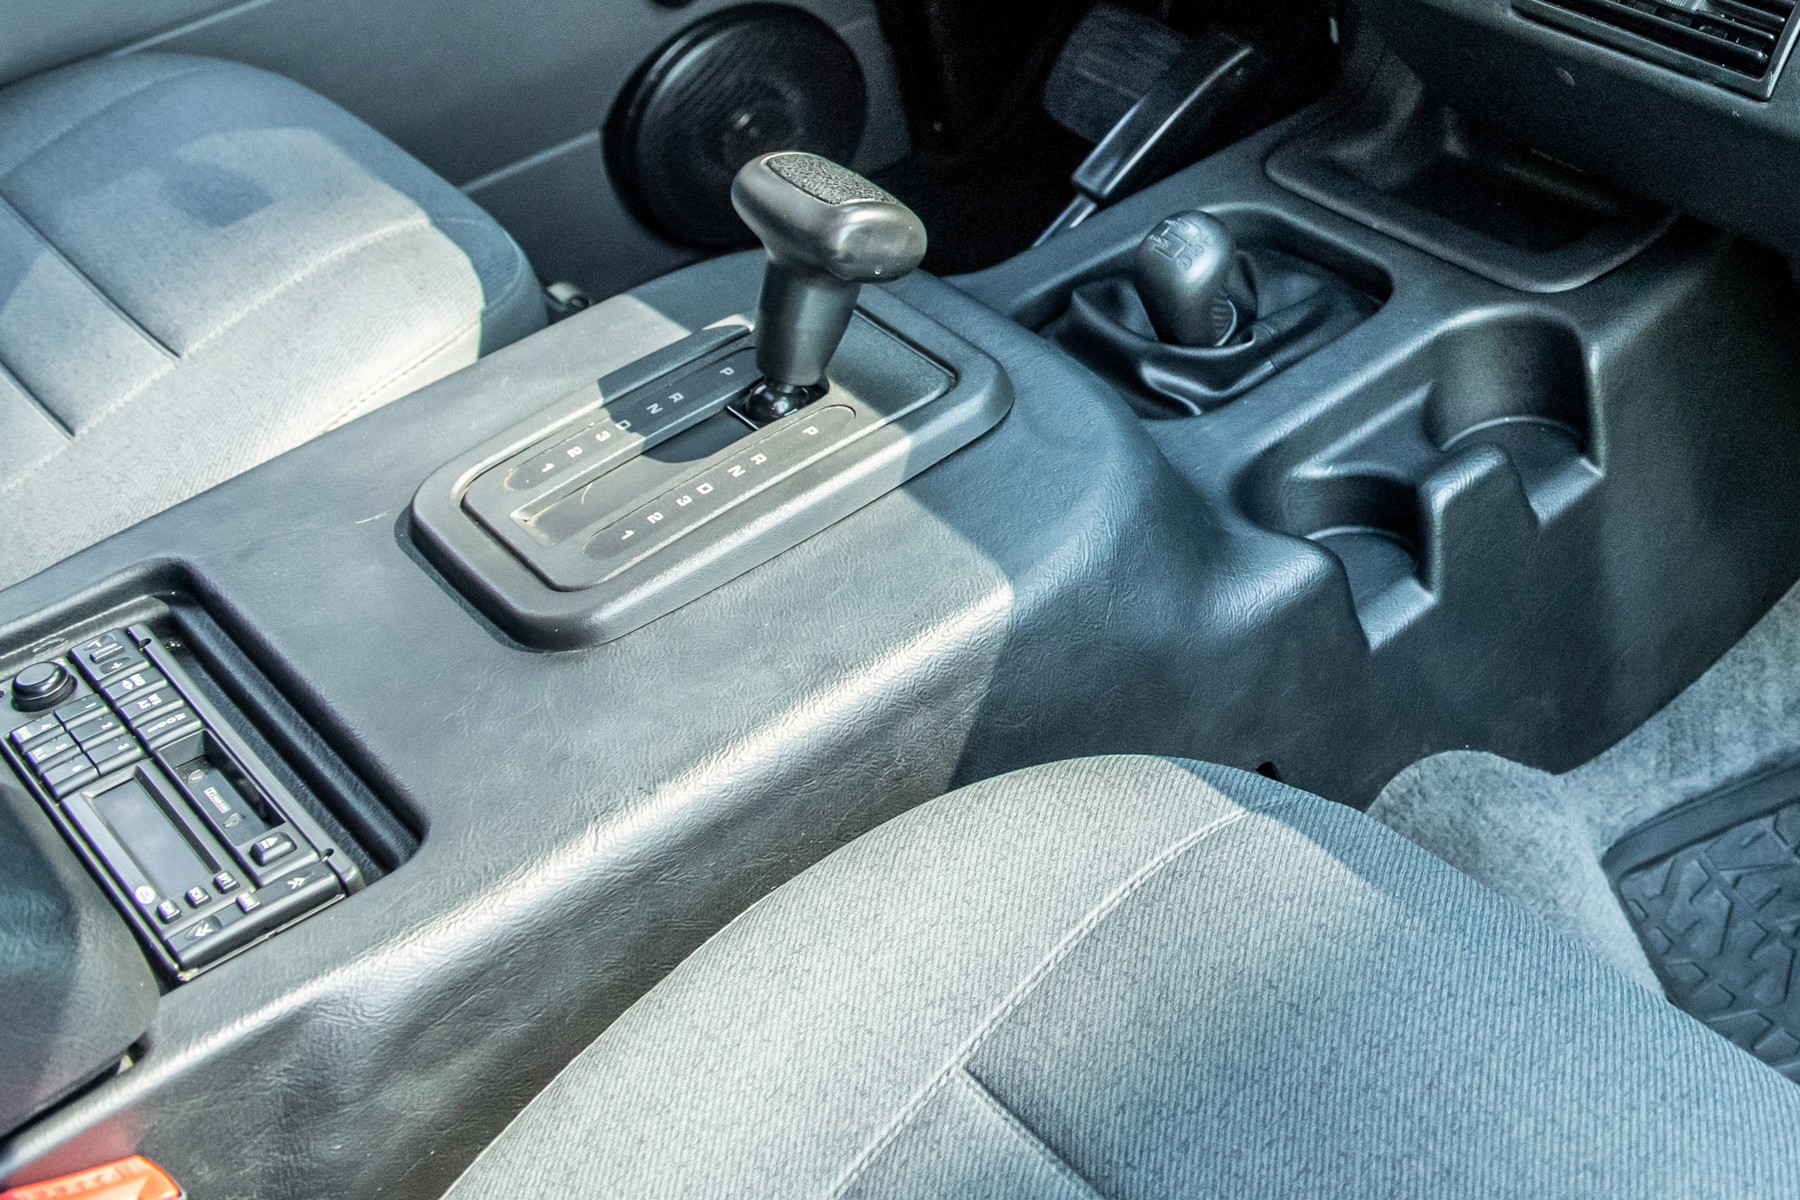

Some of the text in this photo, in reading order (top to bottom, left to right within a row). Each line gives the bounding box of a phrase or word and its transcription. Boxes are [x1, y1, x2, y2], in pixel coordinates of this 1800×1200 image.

[541, 367, 734, 473] P R N D 3 2 1
[621, 425, 819, 540] P R N D 3 2 1
